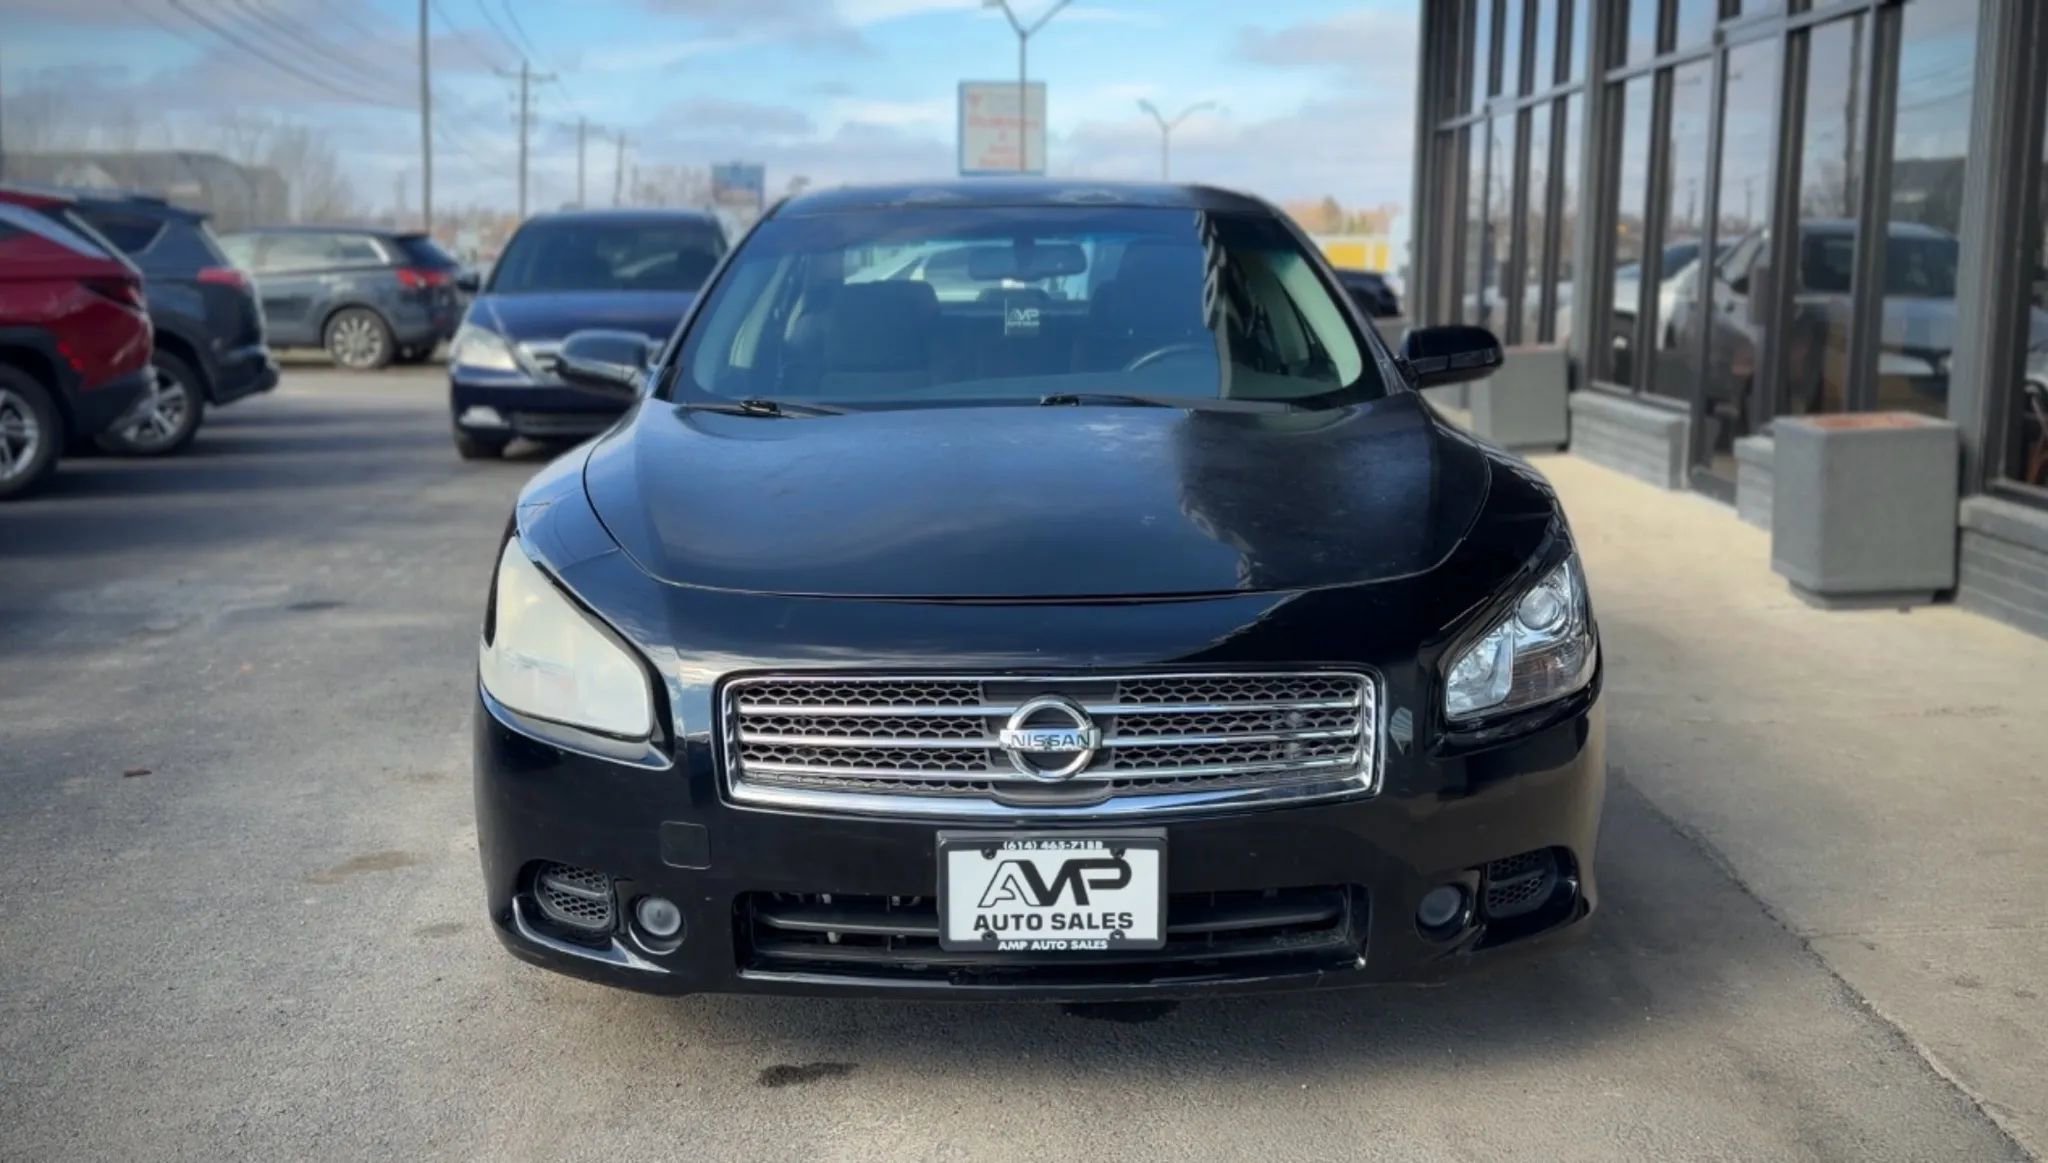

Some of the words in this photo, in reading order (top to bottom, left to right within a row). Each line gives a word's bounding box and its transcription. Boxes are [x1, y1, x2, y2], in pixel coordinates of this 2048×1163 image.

[1010, 734, 1090, 747] NISSAN
[977, 859, 1132, 908] AMP
[973, 914, 1043, 931] AUTO
[1051, 912, 1134, 931] SALES
[998, 940, 1027, 951] AMP
[1031, 940, 1067, 951] AUTO
[1071, 939, 1108, 950] SALES
